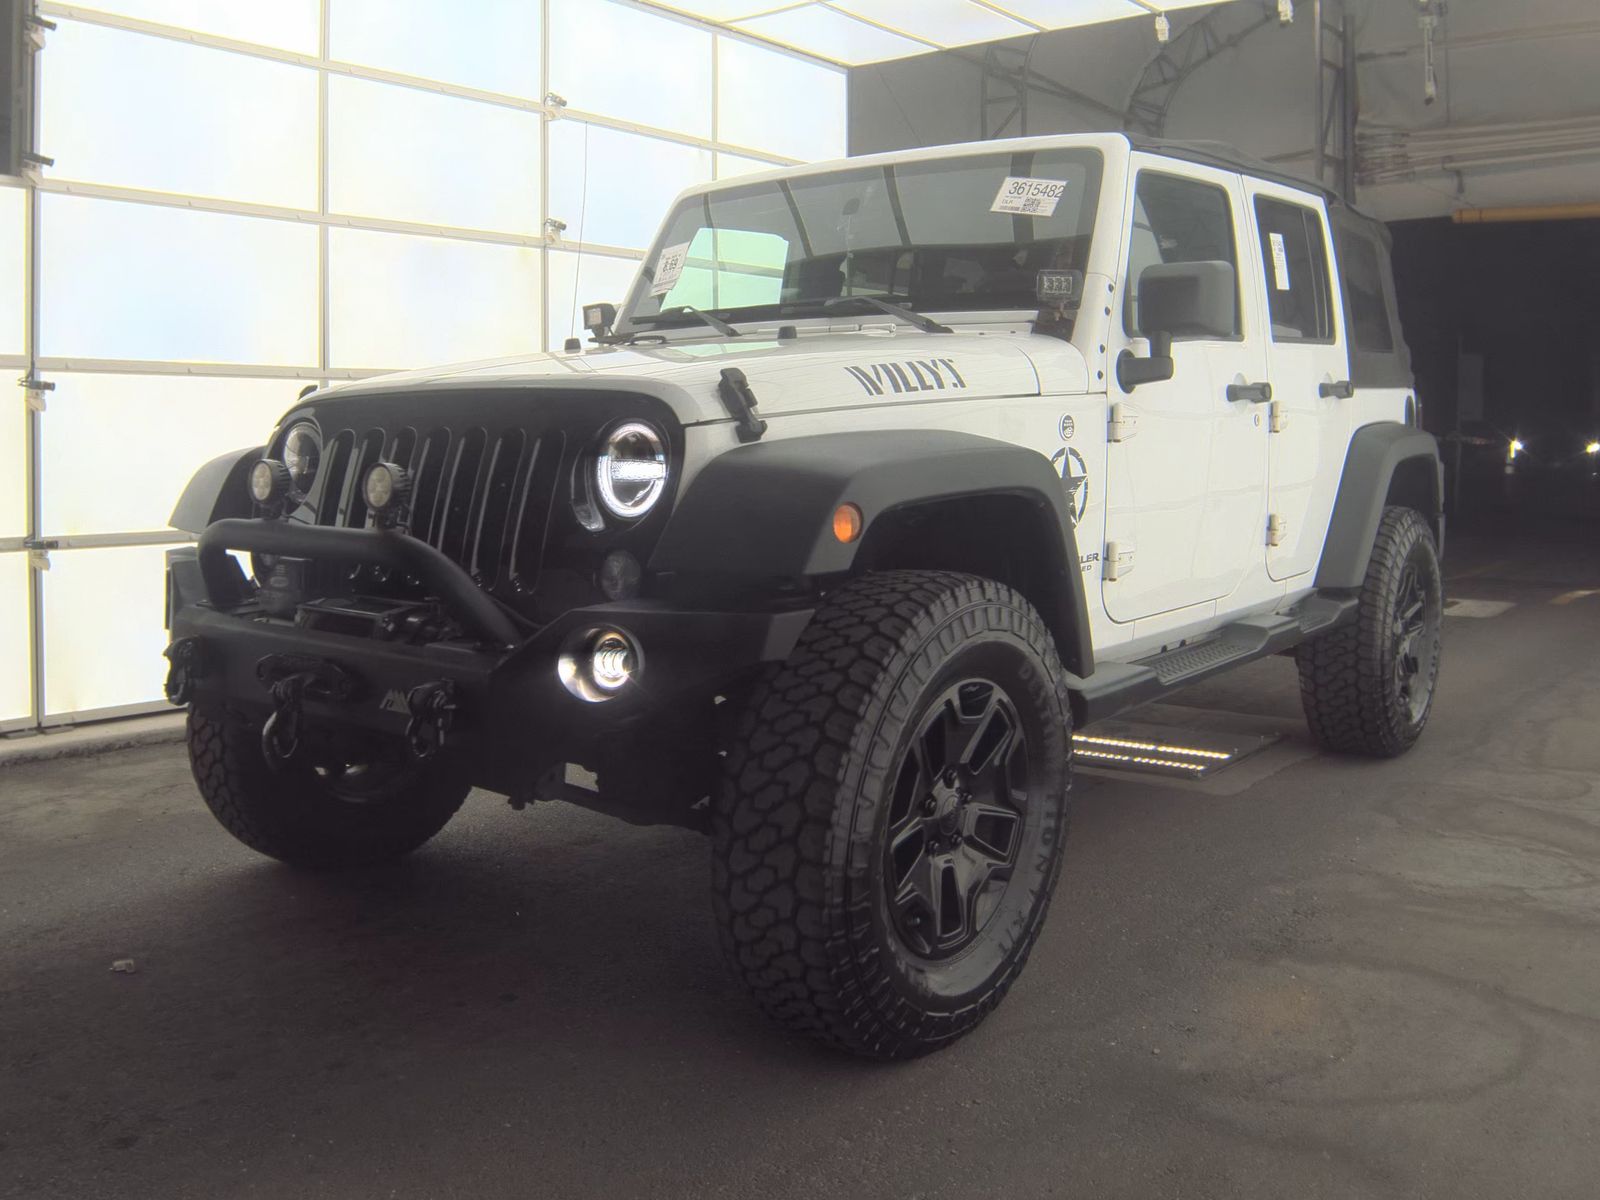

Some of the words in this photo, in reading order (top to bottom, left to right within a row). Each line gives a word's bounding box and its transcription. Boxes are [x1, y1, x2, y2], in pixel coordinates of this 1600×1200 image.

[1008, 181, 1066, 198] 3615482
[843, 358, 967, 396] WILLYS
[1080, 552, 1099, 564] LER
